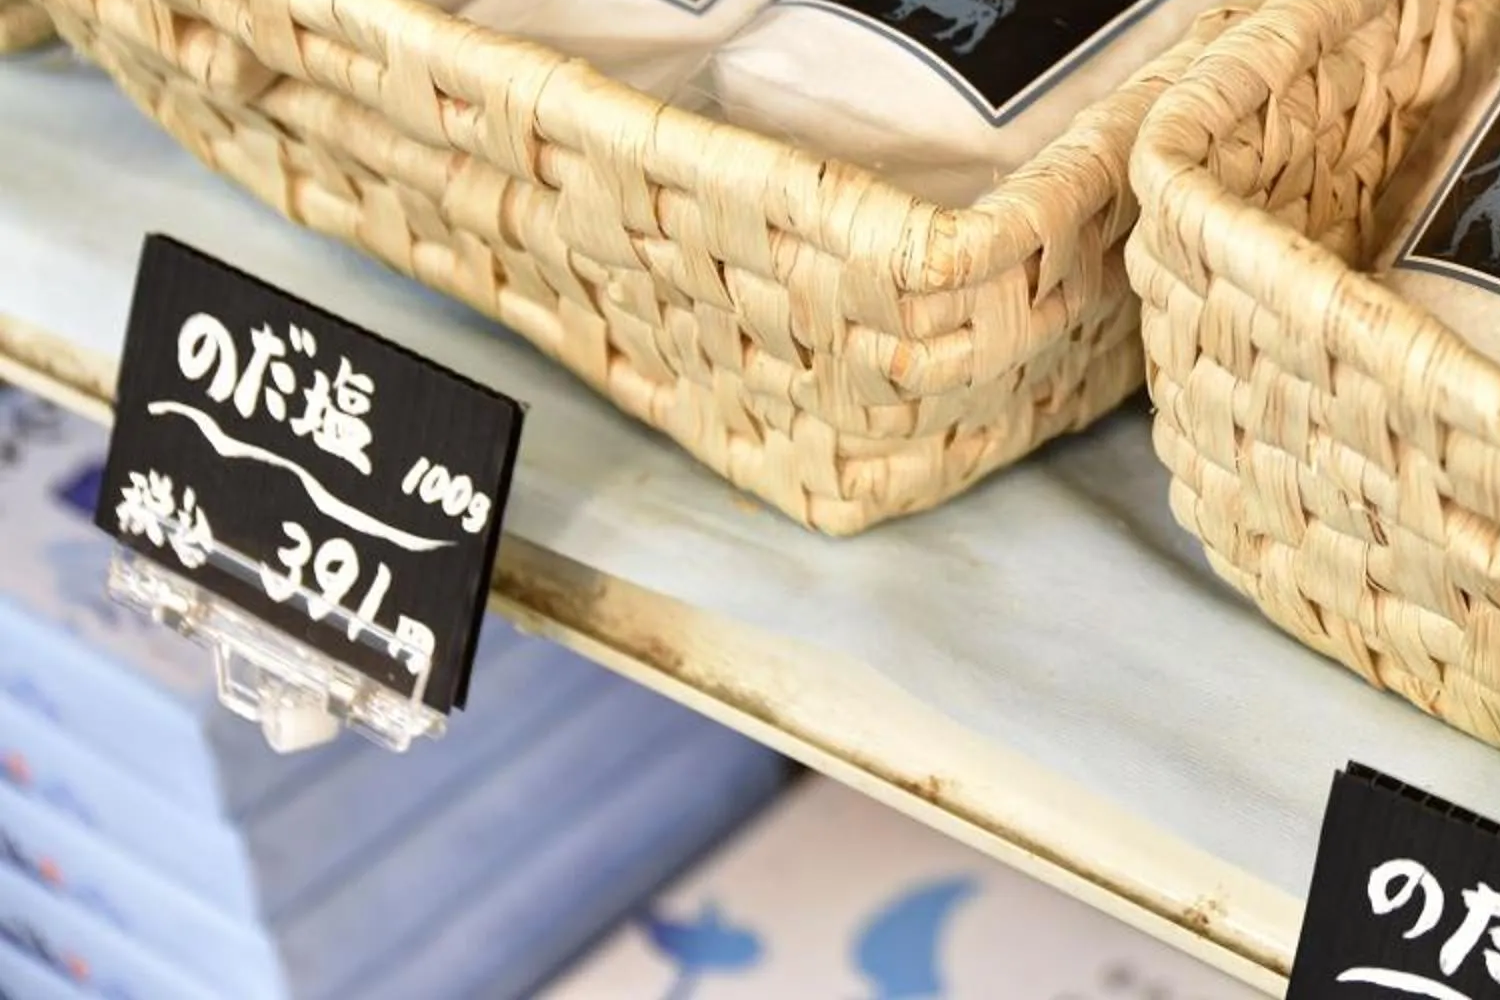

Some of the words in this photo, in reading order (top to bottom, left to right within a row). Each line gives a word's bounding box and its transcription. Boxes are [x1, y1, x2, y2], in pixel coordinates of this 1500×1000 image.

[177, 312, 376, 475] のだ塩
[402, 456, 492, 534] 100g
